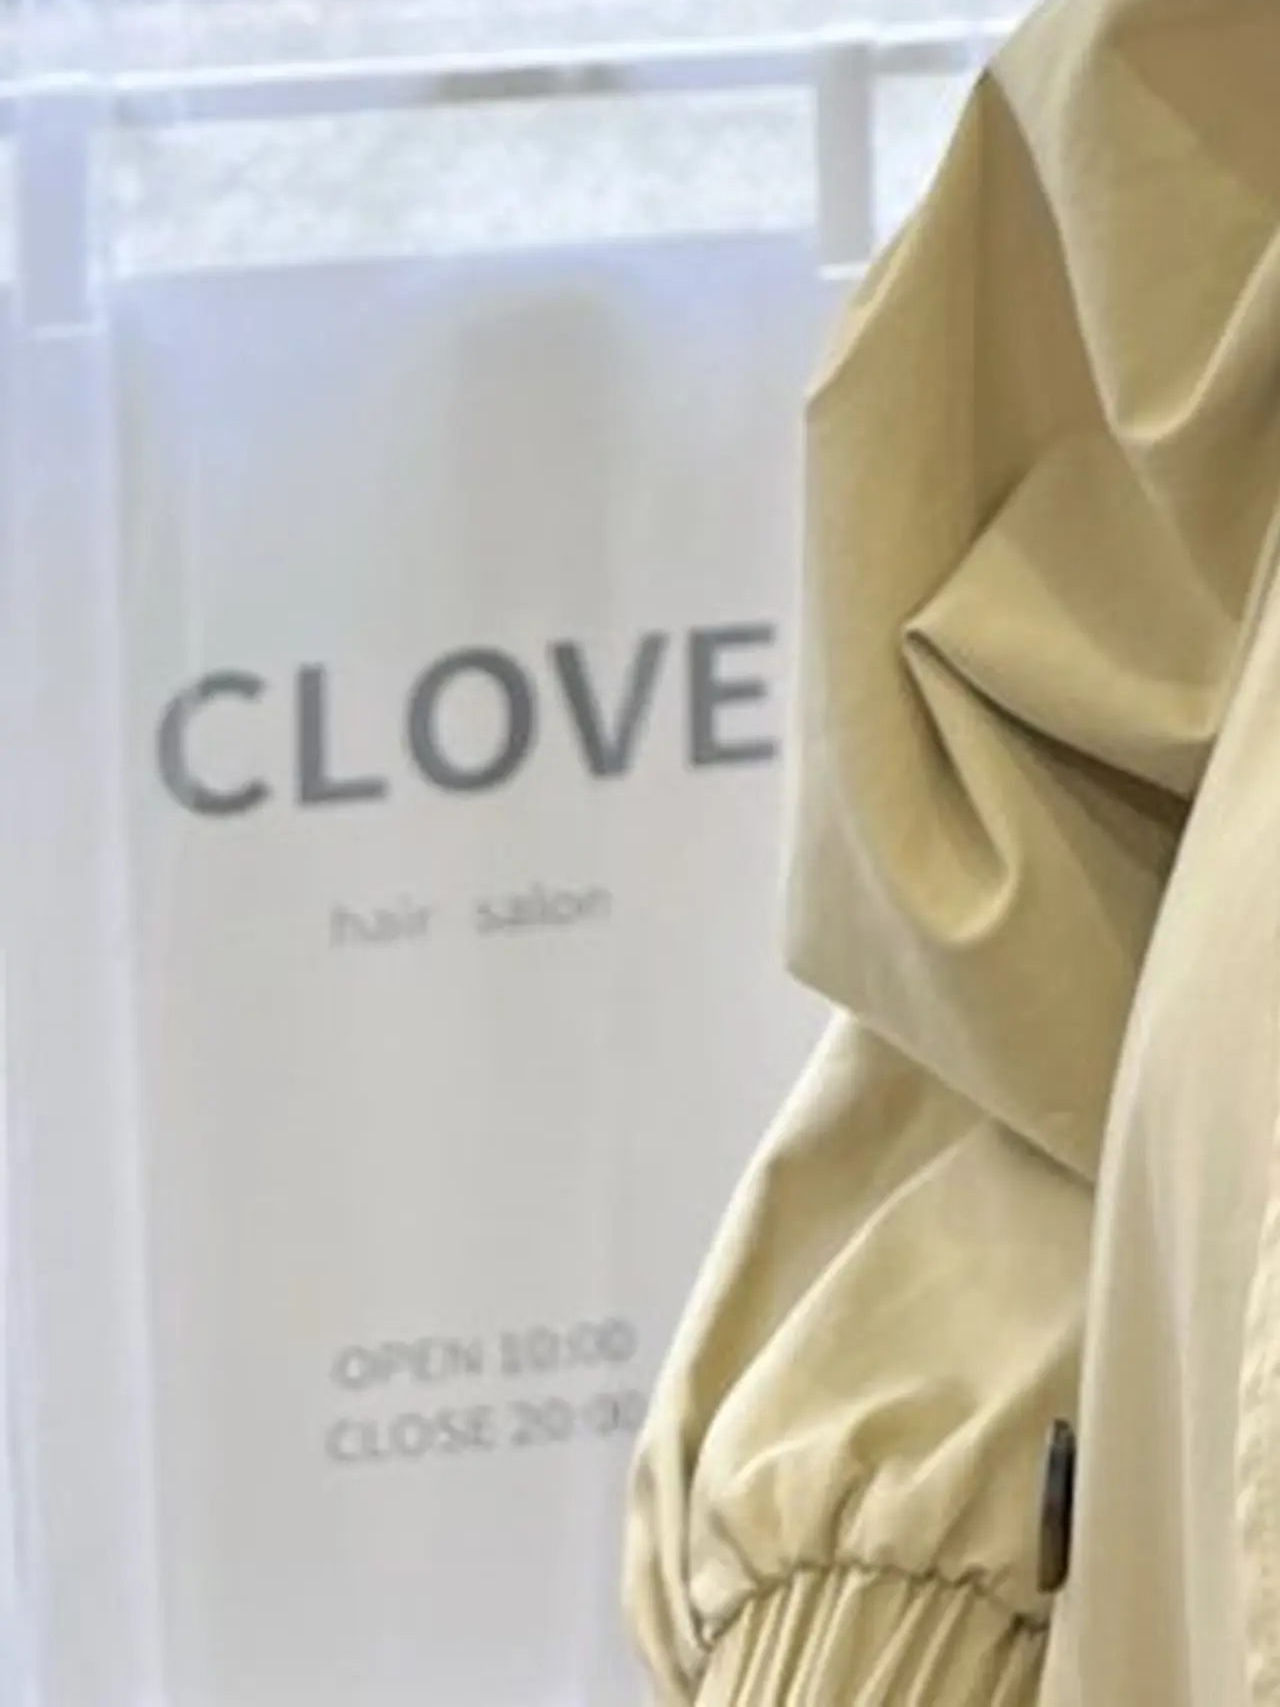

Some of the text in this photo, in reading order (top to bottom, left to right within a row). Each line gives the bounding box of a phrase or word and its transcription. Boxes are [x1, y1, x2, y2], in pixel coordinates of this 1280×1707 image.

[157, 623, 777, 816] CLOVE
[331, 881, 613, 948] hair salon
[332, 1338, 483, 1389] OPEN
[326, 1403, 495, 1462] CLOSE
